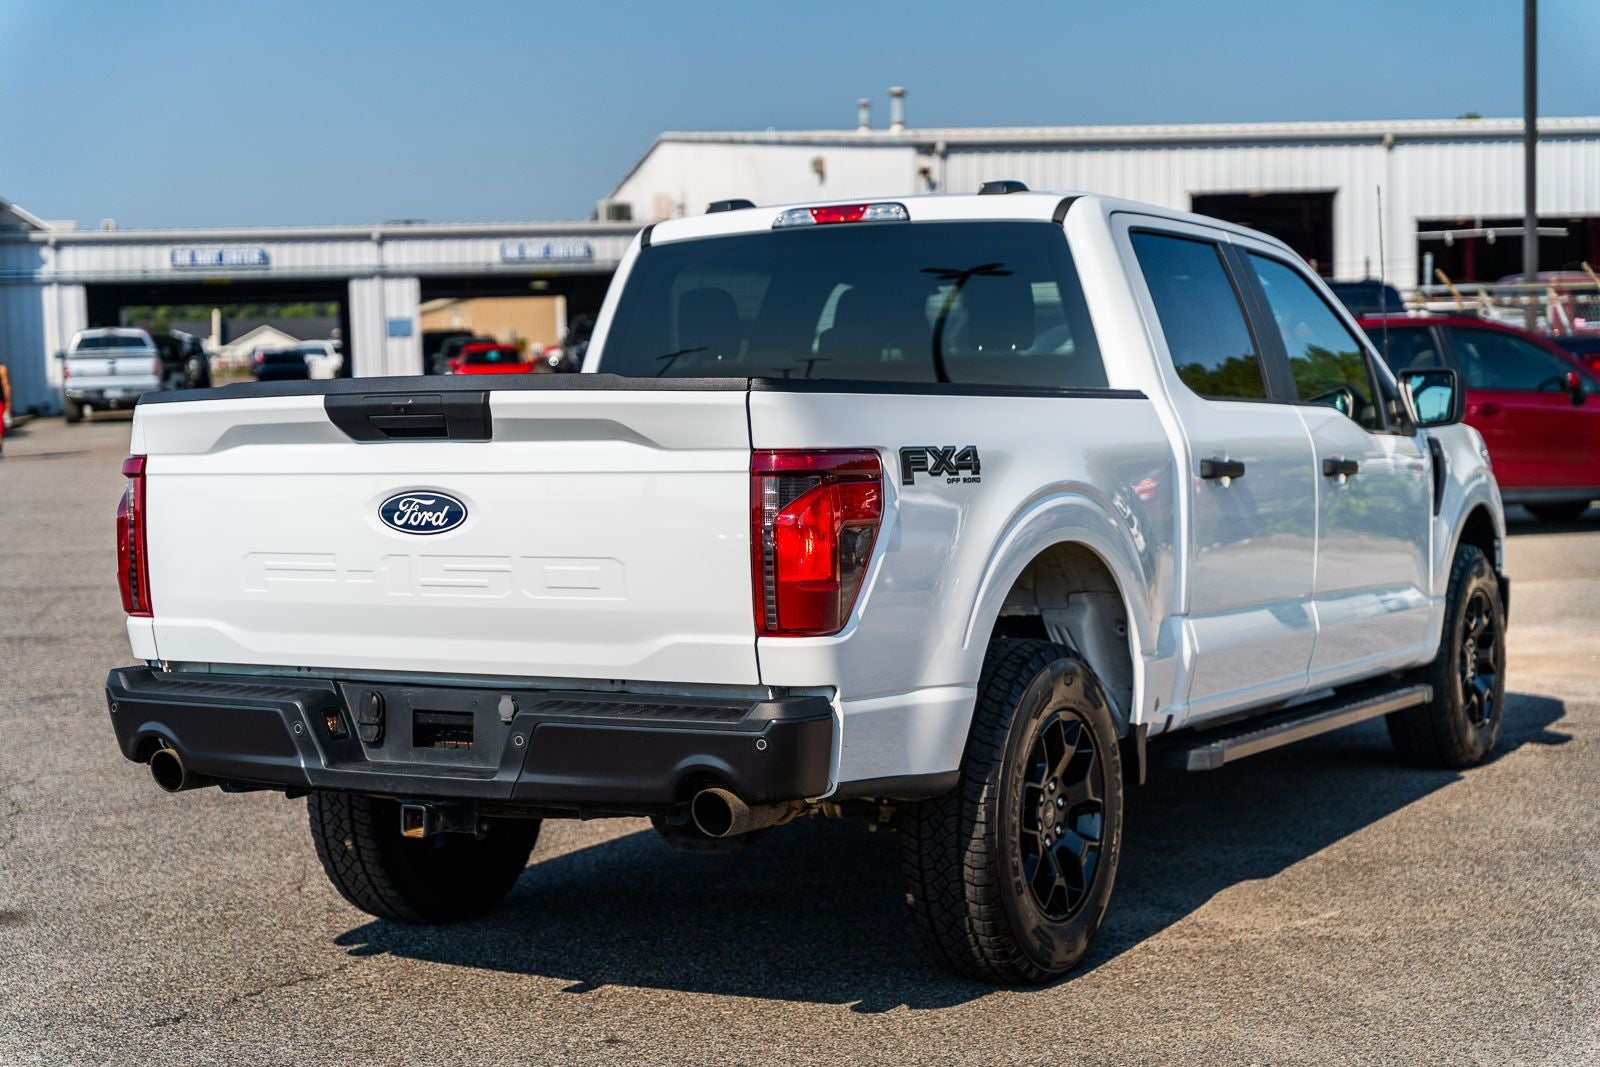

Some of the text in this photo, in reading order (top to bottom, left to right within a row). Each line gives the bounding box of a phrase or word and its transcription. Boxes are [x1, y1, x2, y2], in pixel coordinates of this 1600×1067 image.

[899, 445, 981, 485] FX4
[393, 497, 450, 527] Ford
[241, 551, 628, 601] F-150
